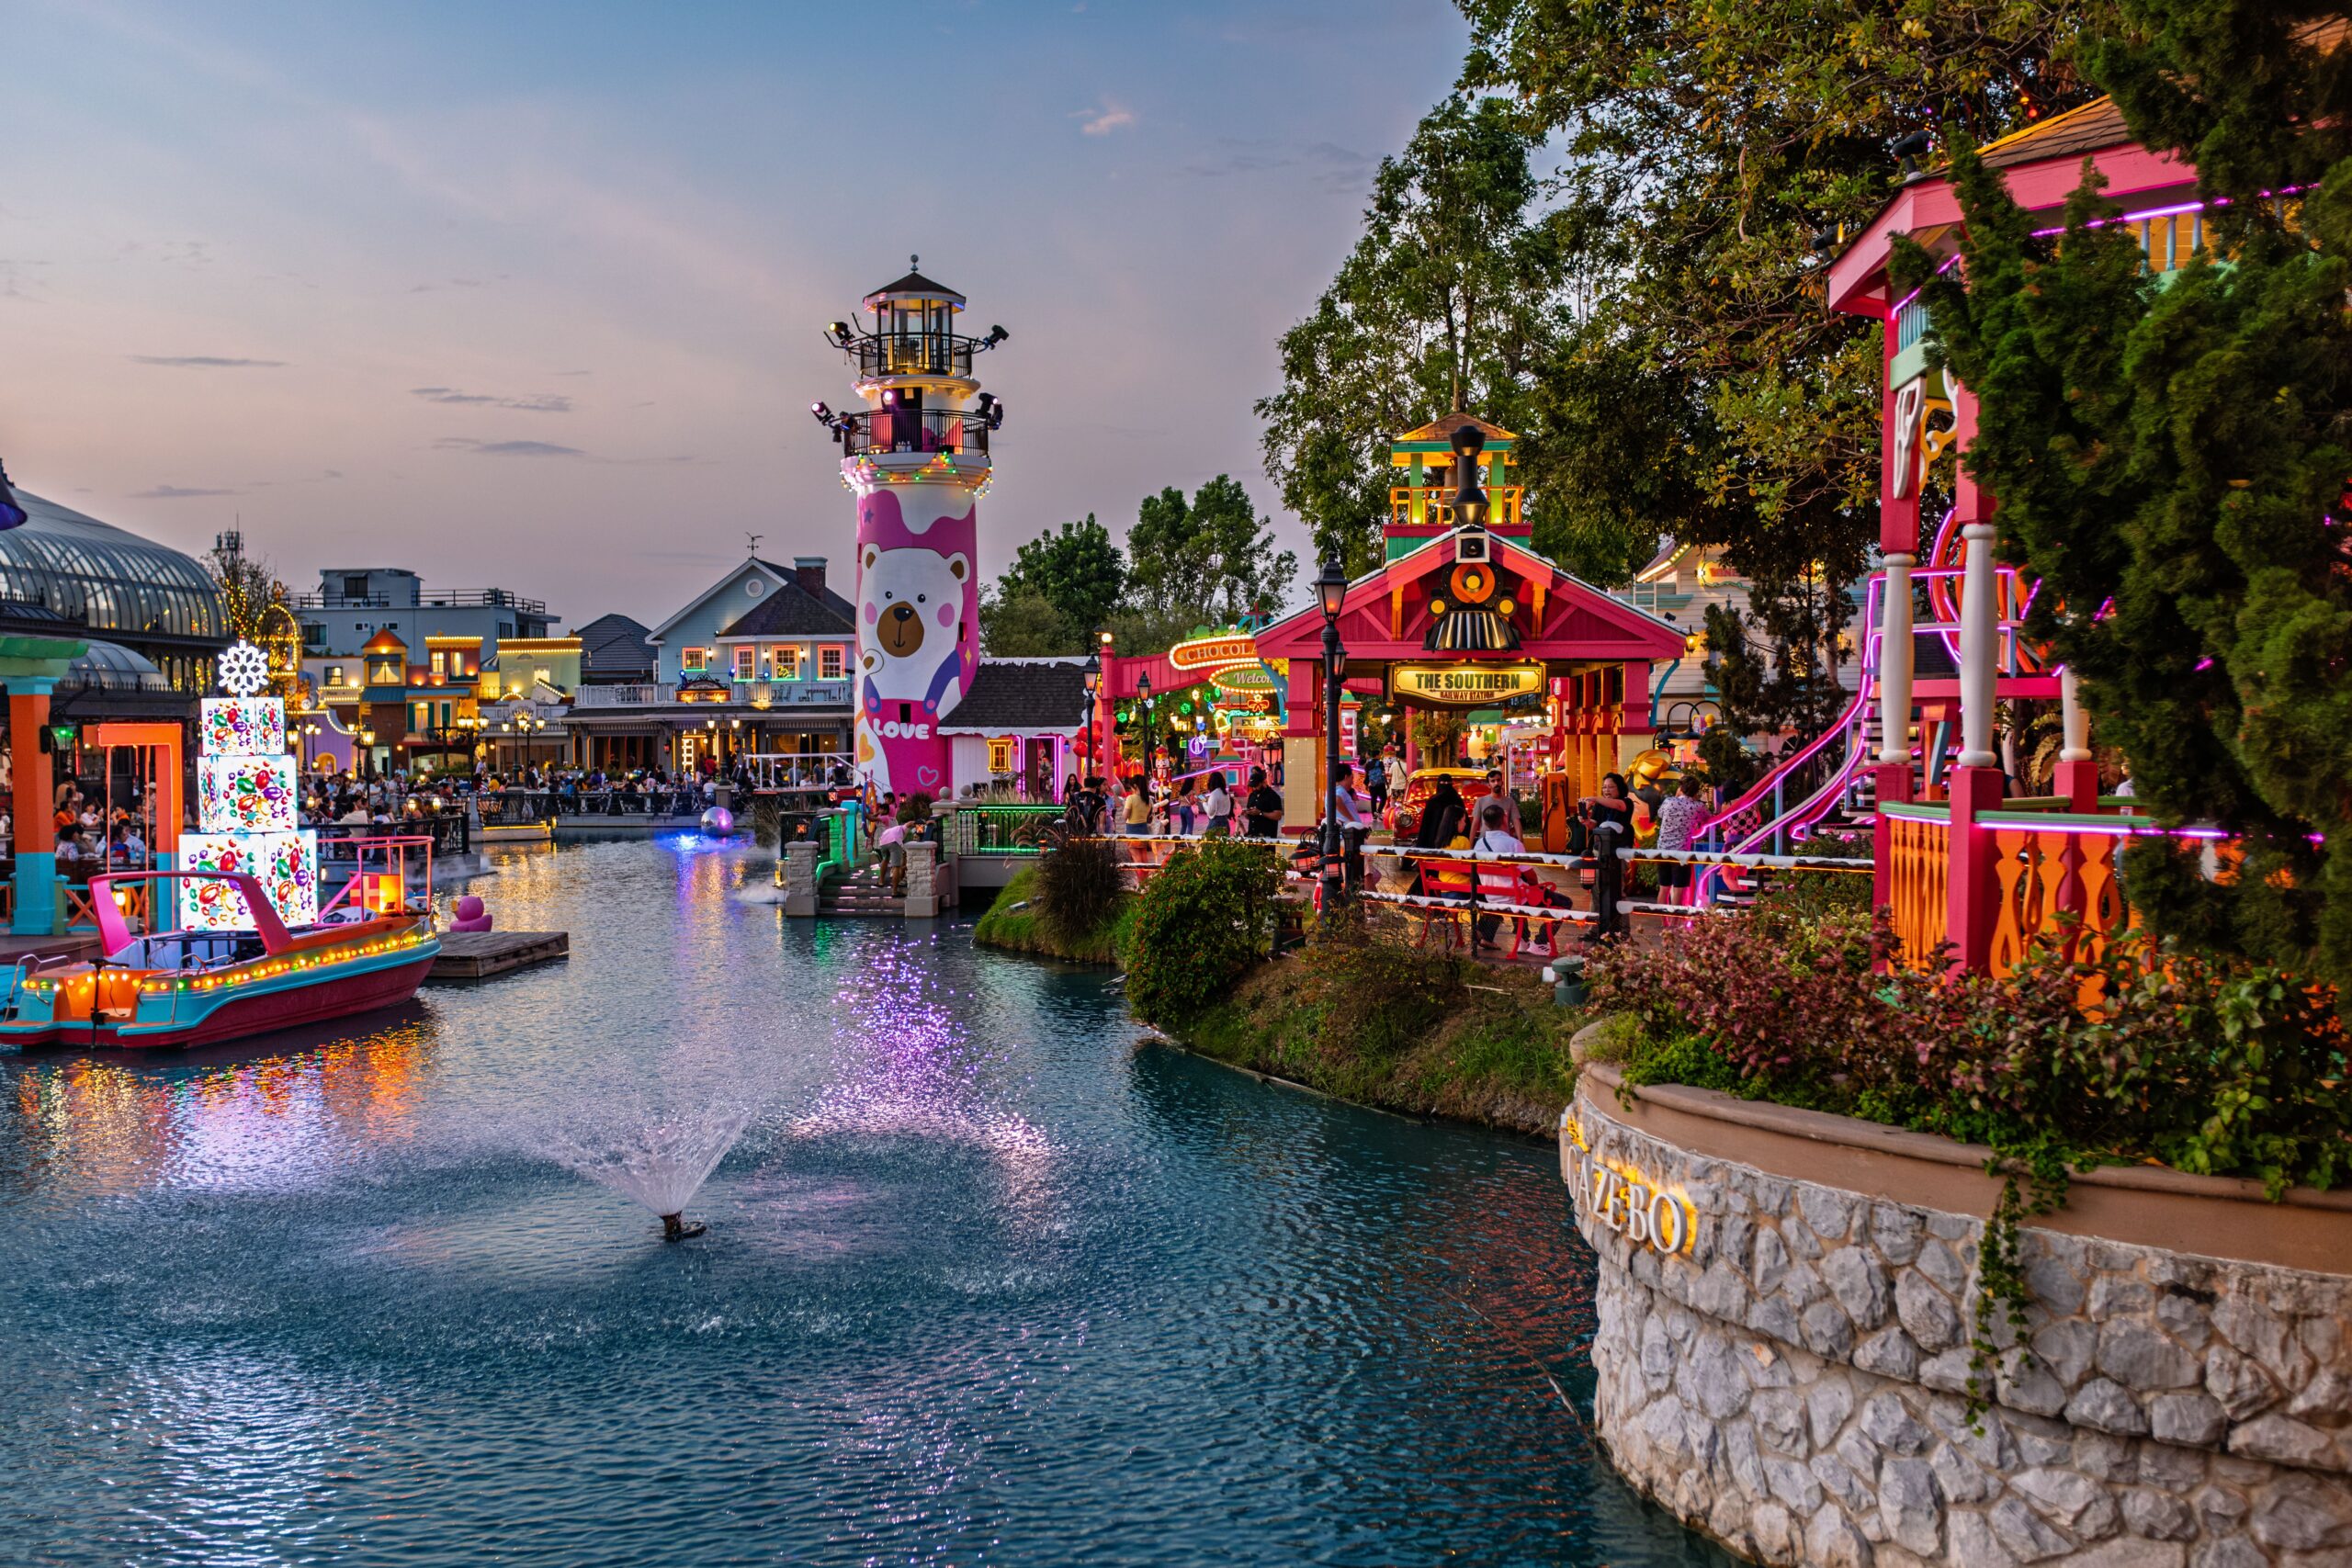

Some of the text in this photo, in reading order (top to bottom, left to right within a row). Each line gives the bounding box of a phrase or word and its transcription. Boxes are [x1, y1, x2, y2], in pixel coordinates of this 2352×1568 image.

[1416, 673, 1520, 689] THE SOUTHERN
[1441, 691, 1495, 701] RAILWAY STATION
[873, 718, 930, 739] LOVE
[1567, 1145, 1683, 1253] GAZEBO
